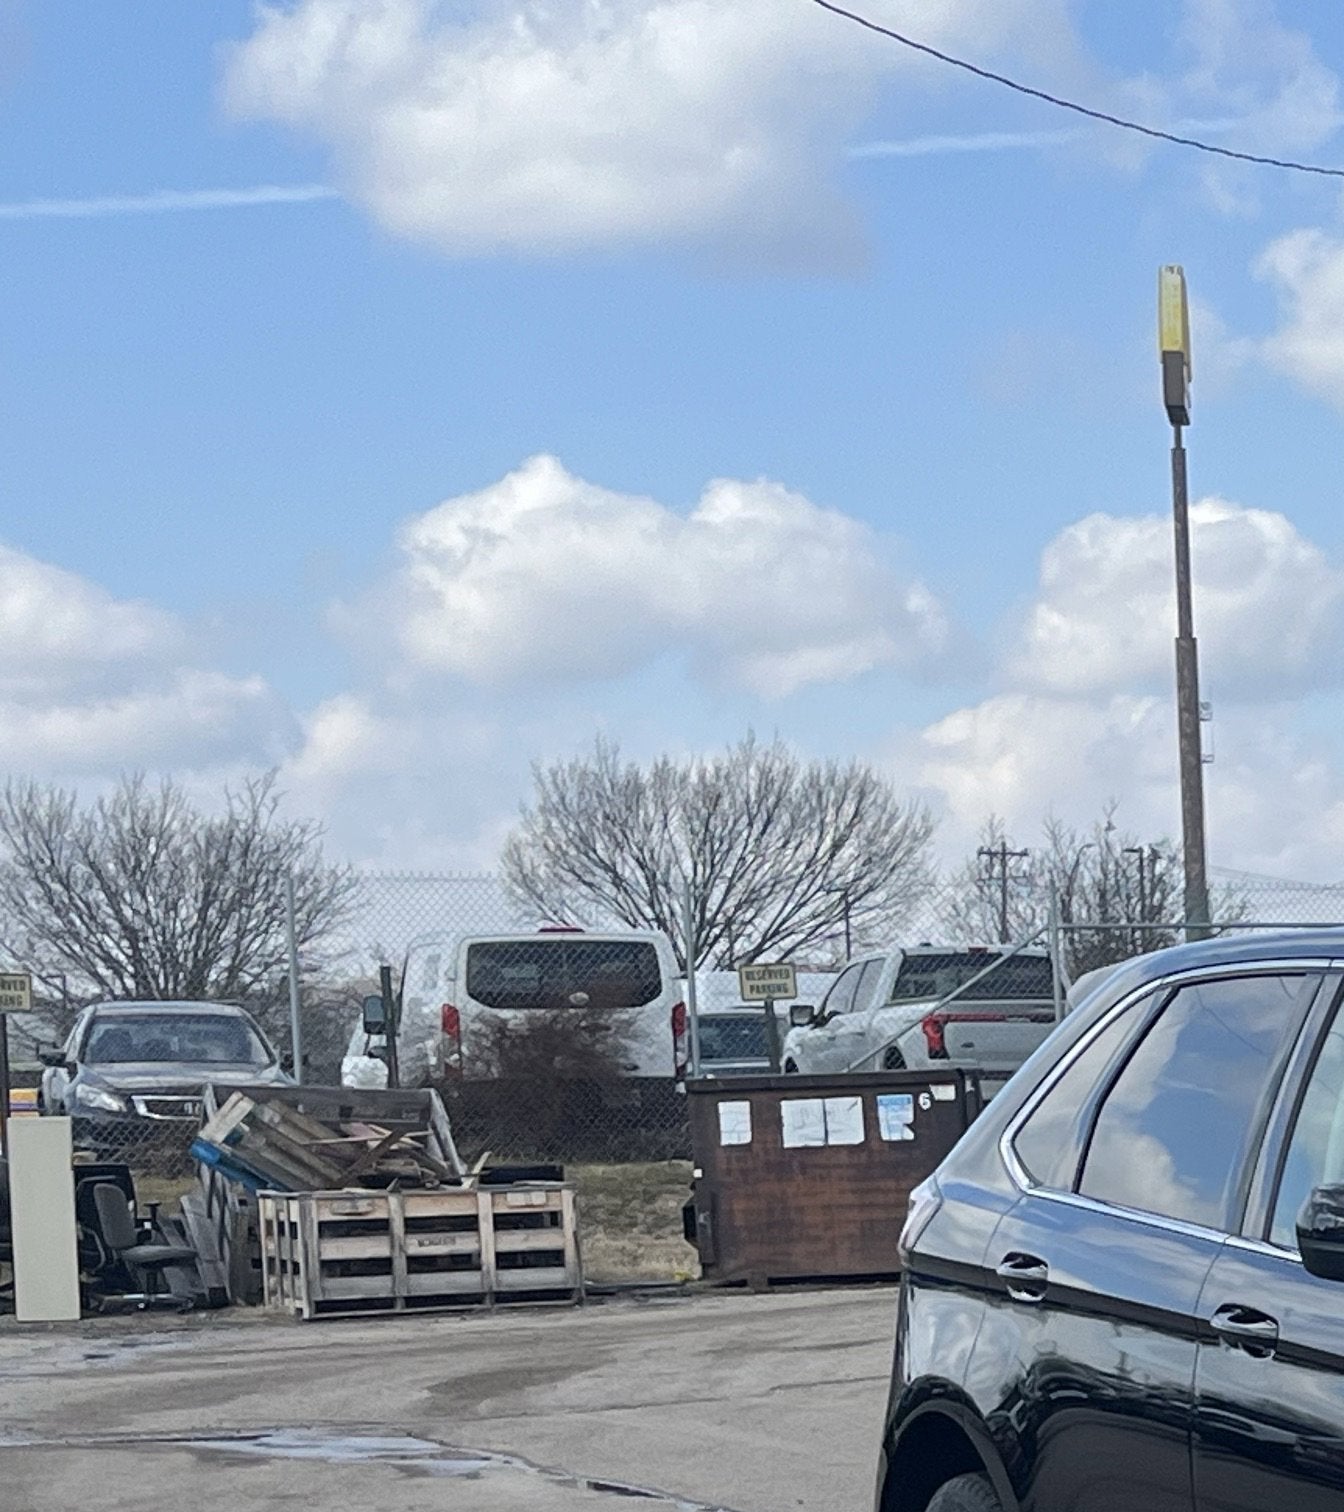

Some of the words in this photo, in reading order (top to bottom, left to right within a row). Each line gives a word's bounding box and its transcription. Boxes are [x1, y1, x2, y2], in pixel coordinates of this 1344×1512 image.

[745, 968, 790, 981] RESERVED
[750, 984, 789, 995] PARKING
[918, 1092, 931, 1110] 6
